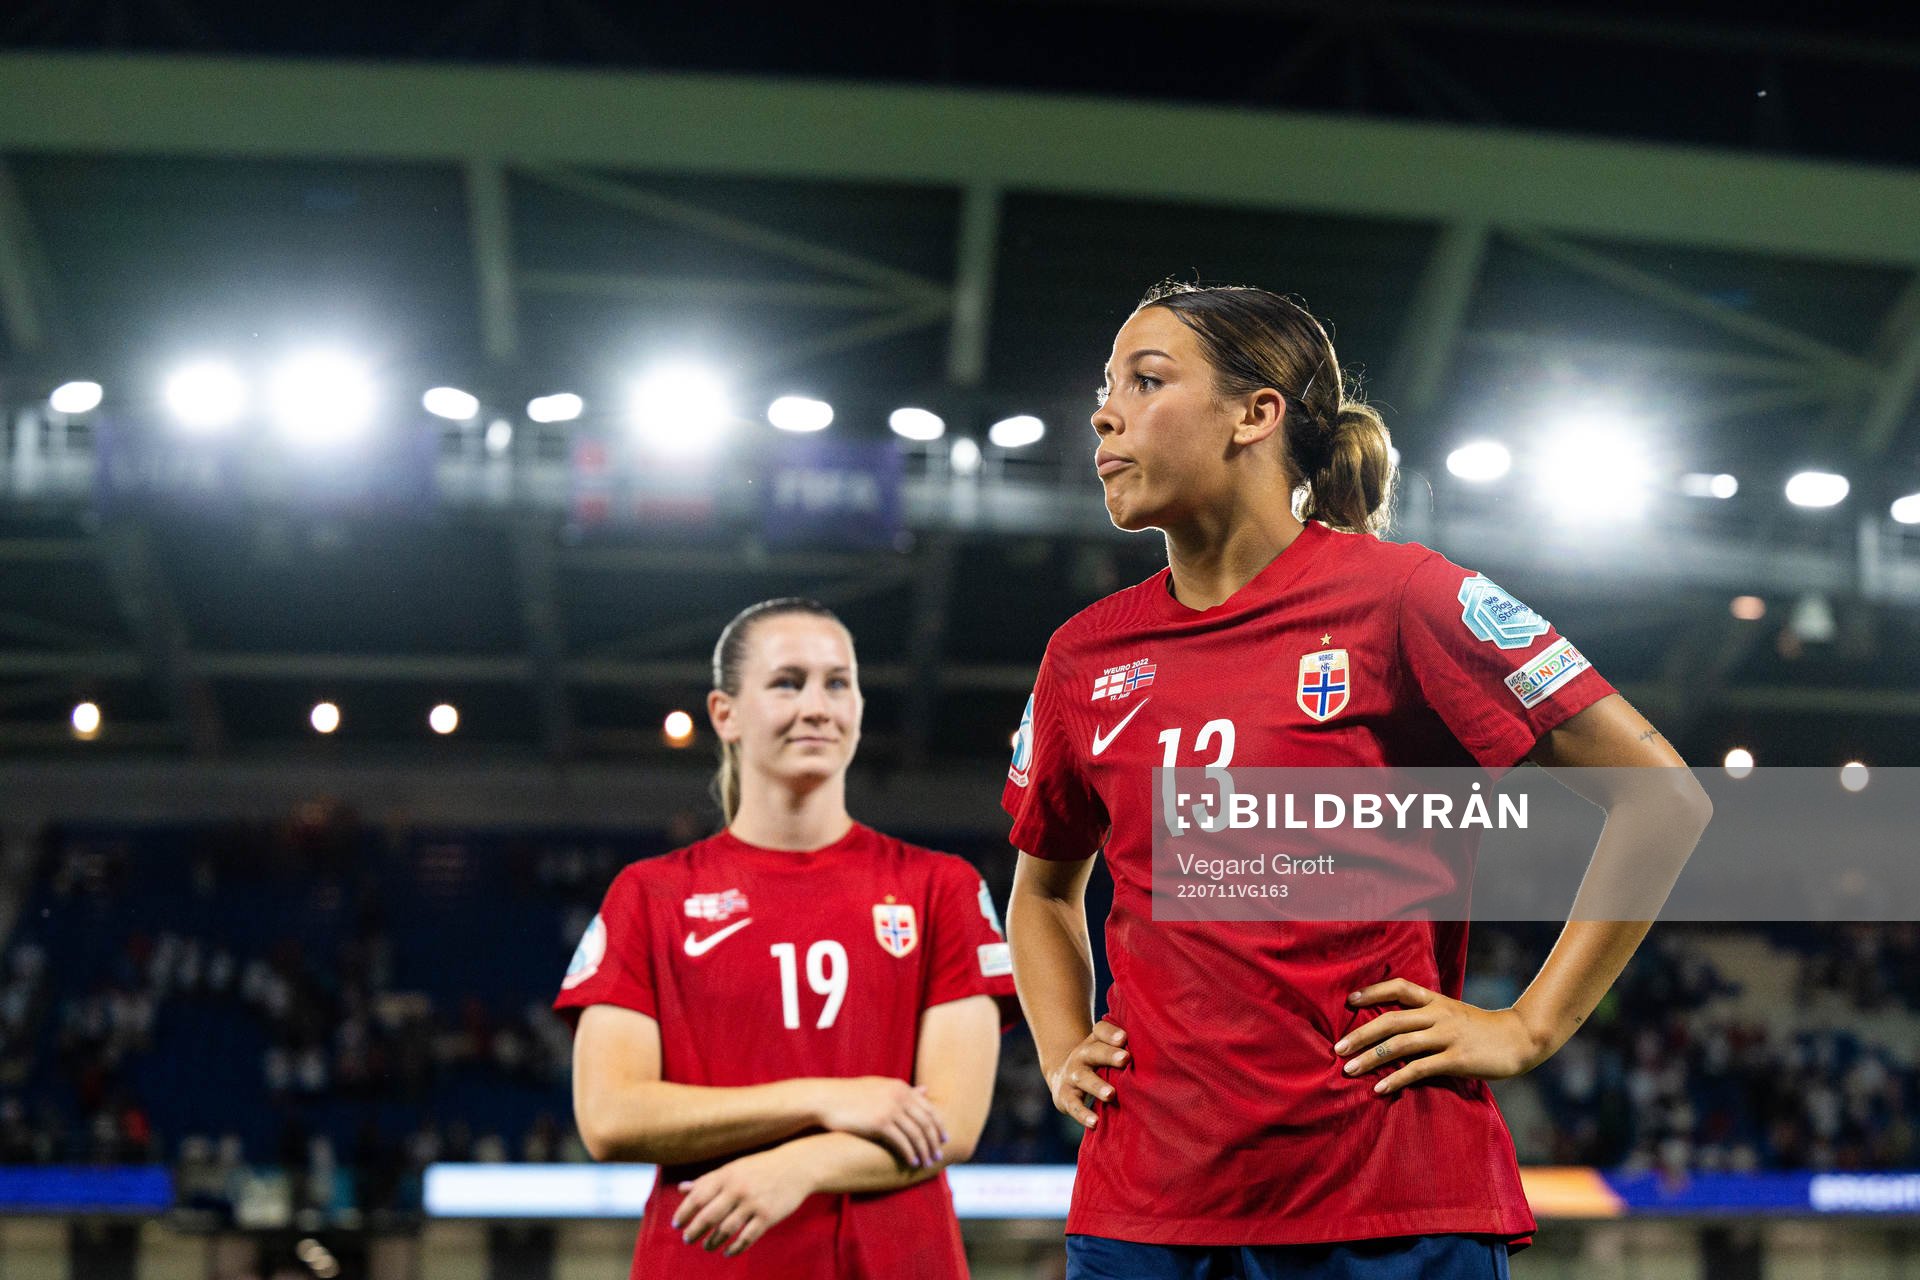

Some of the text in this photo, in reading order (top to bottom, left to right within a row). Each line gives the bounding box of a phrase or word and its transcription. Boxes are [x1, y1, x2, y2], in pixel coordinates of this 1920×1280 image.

[1491, 601, 1513, 614] Play
[1498, 604, 1529, 621] Strong
[1104, 658, 1149, 675] WEURO 2022
[1157, 718, 1236, 837] 13
[769, 940, 849, 1030] 19
